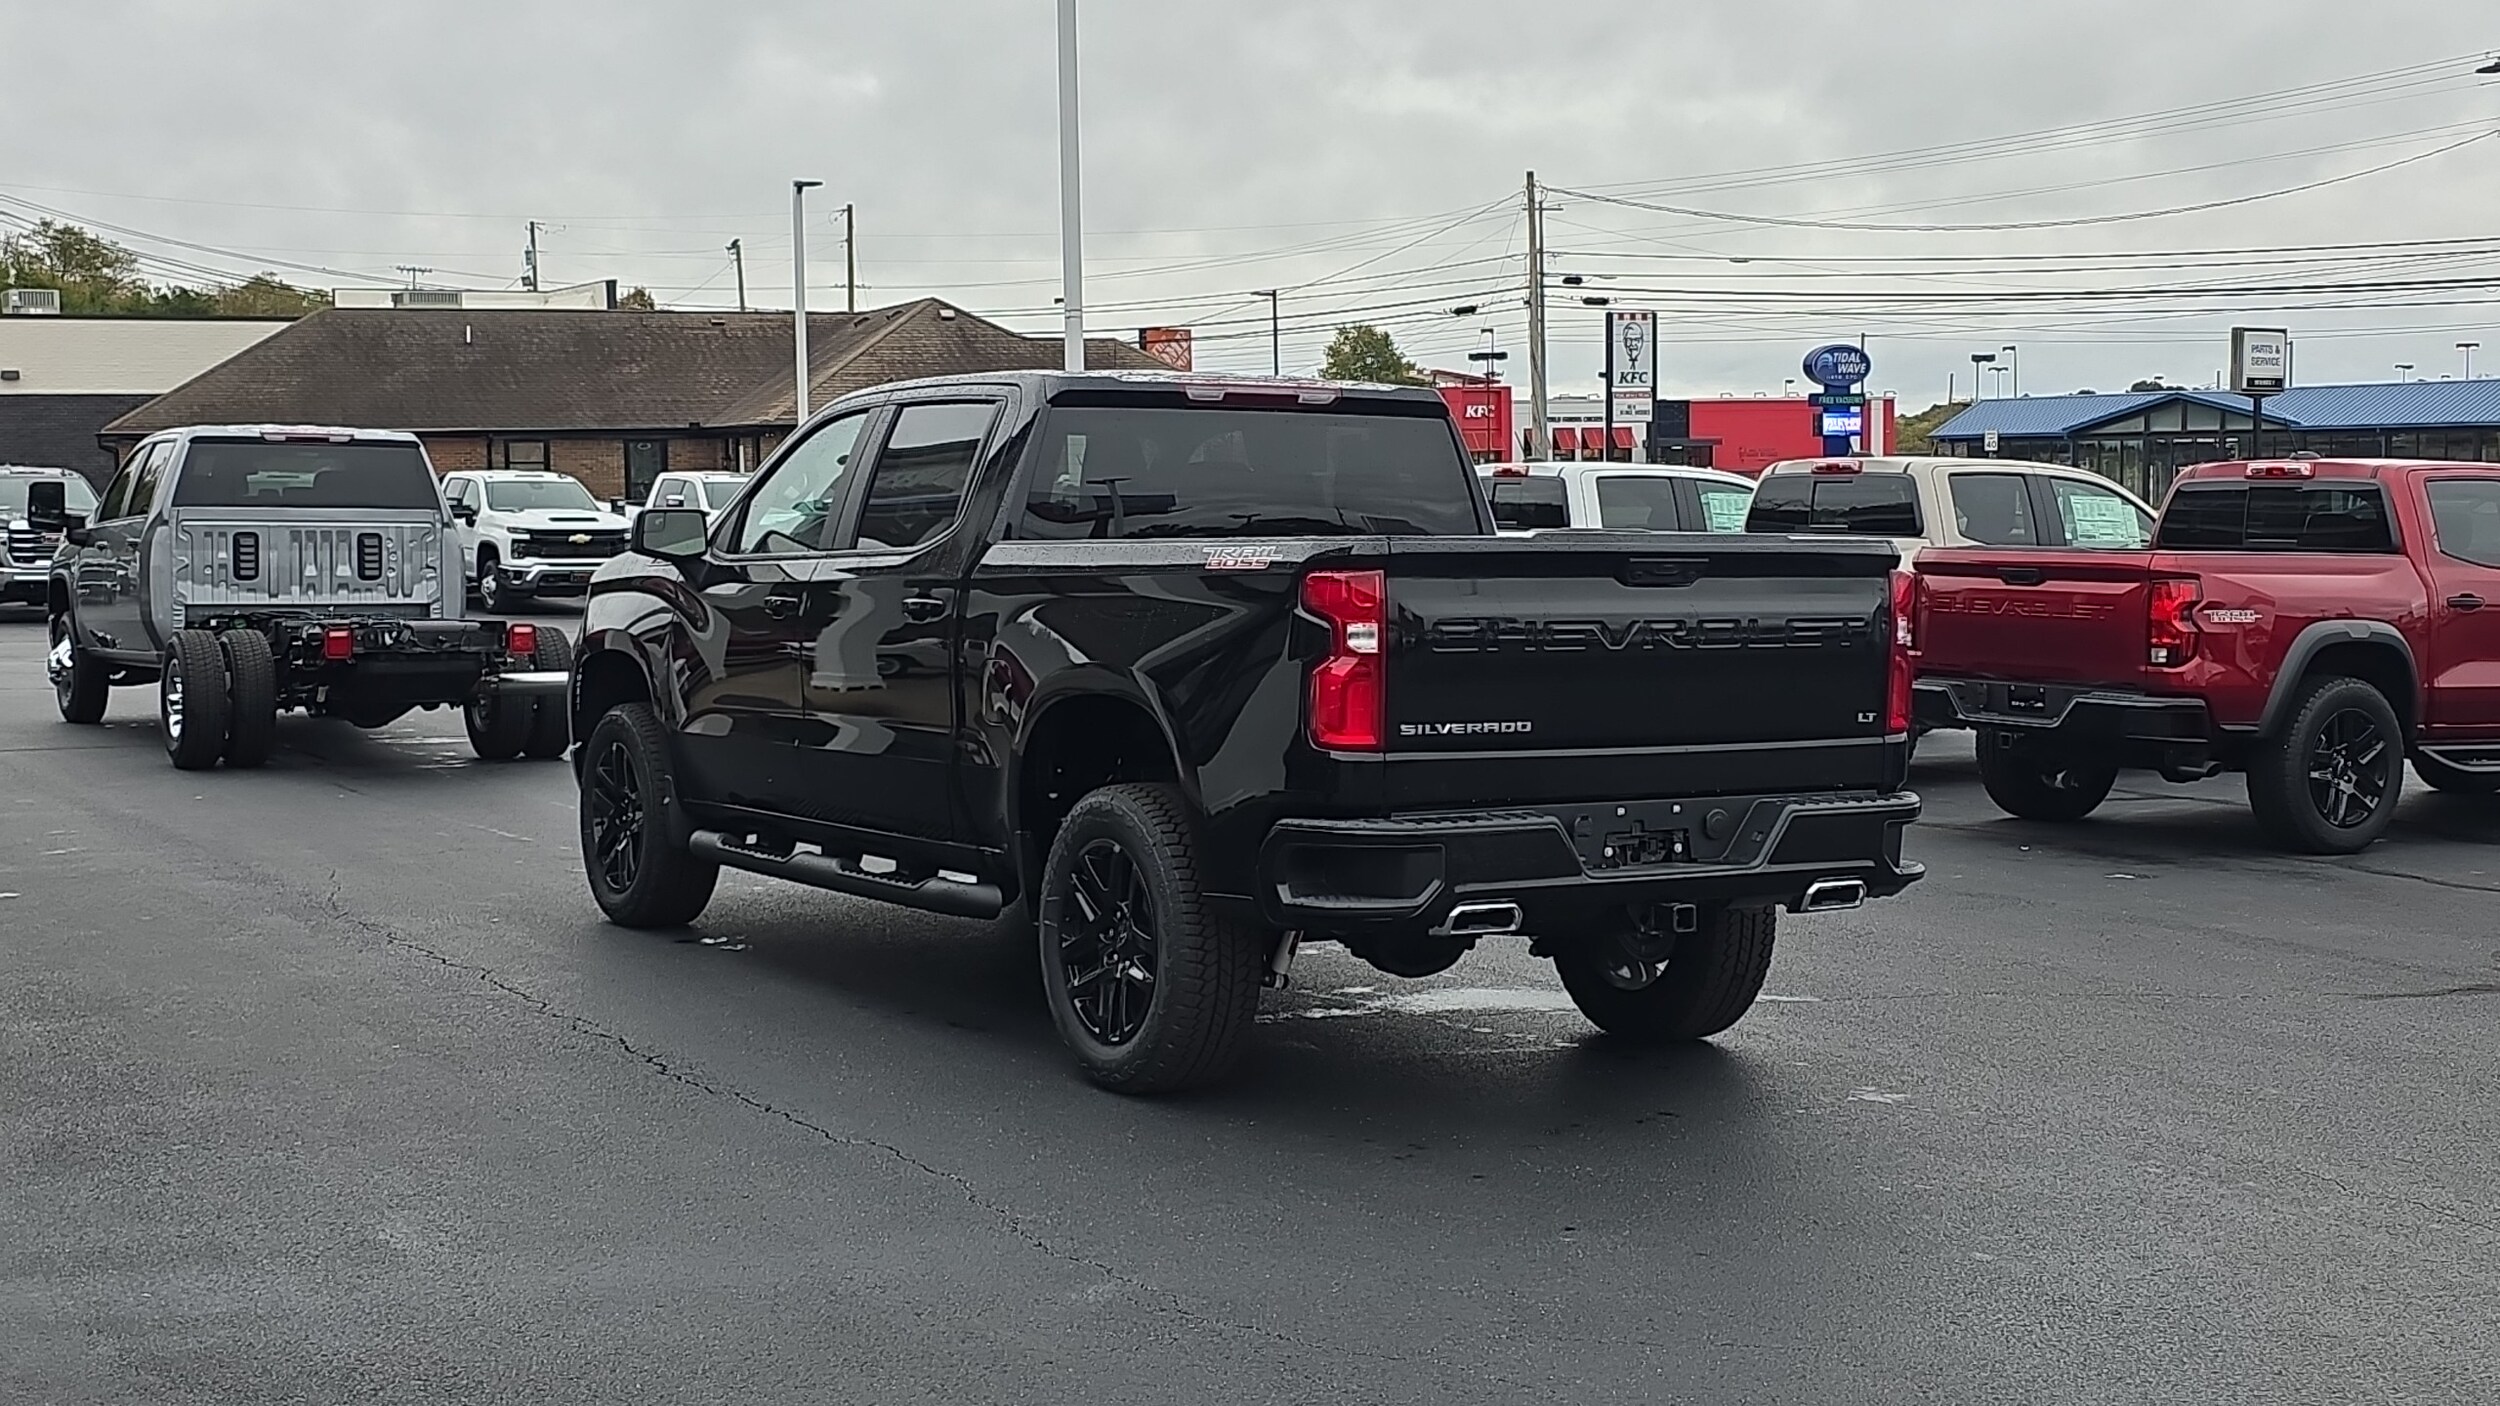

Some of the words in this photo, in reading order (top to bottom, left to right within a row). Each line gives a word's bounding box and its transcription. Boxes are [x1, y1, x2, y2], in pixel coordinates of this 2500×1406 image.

[2251, 344, 2273, 354] PARTS
[1833, 352, 1861, 363] TIDAL
[2251, 356, 2281, 366] SERVICE
[1837, 363, 1867, 374] WAVE
[1618, 371, 1648, 384] KFC
[1465, 404, 1496, 418] KFC
[1986, 440, 1997, 449] 40
[1202, 545, 1284, 560] TRAIL
[1204, 558, 1271, 570] BOSS
[1933, 598, 2115, 620] CHEVROLET
[1432, 616, 1868, 652] CHEVROLET
[1856, 711, 1878, 723] LT
[1399, 720, 1533, 737] SILVERADO
